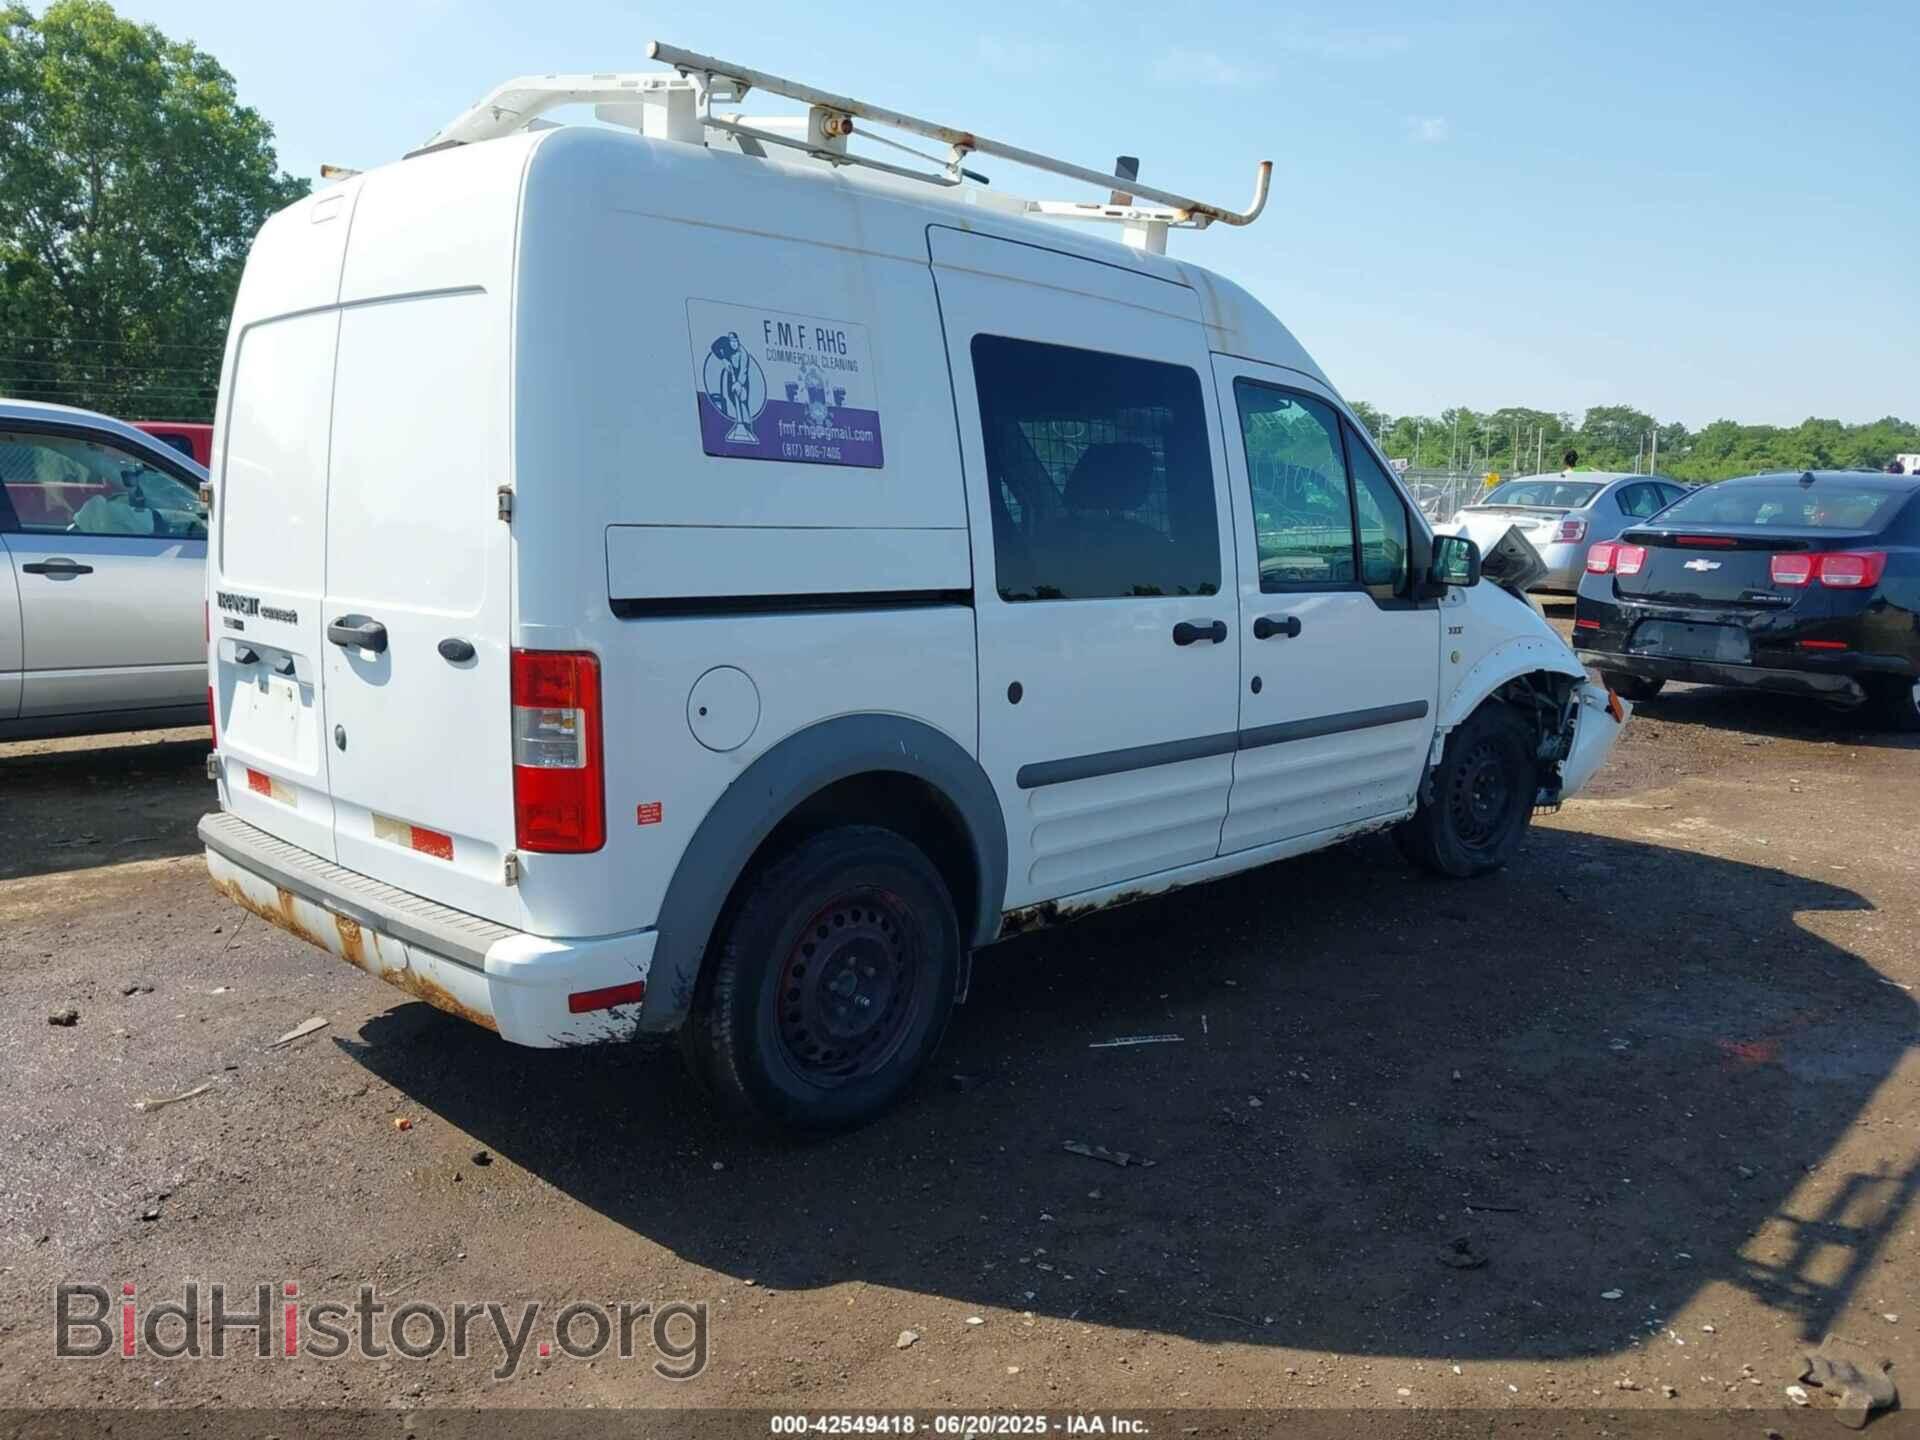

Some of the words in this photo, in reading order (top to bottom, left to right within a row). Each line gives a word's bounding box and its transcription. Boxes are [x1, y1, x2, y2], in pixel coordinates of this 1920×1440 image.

[763, 320, 812, 350] F.M.F.
[816, 328, 847, 355] RHG
[766, 349, 820, 368] COMMERCIAL
[821, 356, 859, 373] CLEANING
[782, 442, 802, 458] (817)
